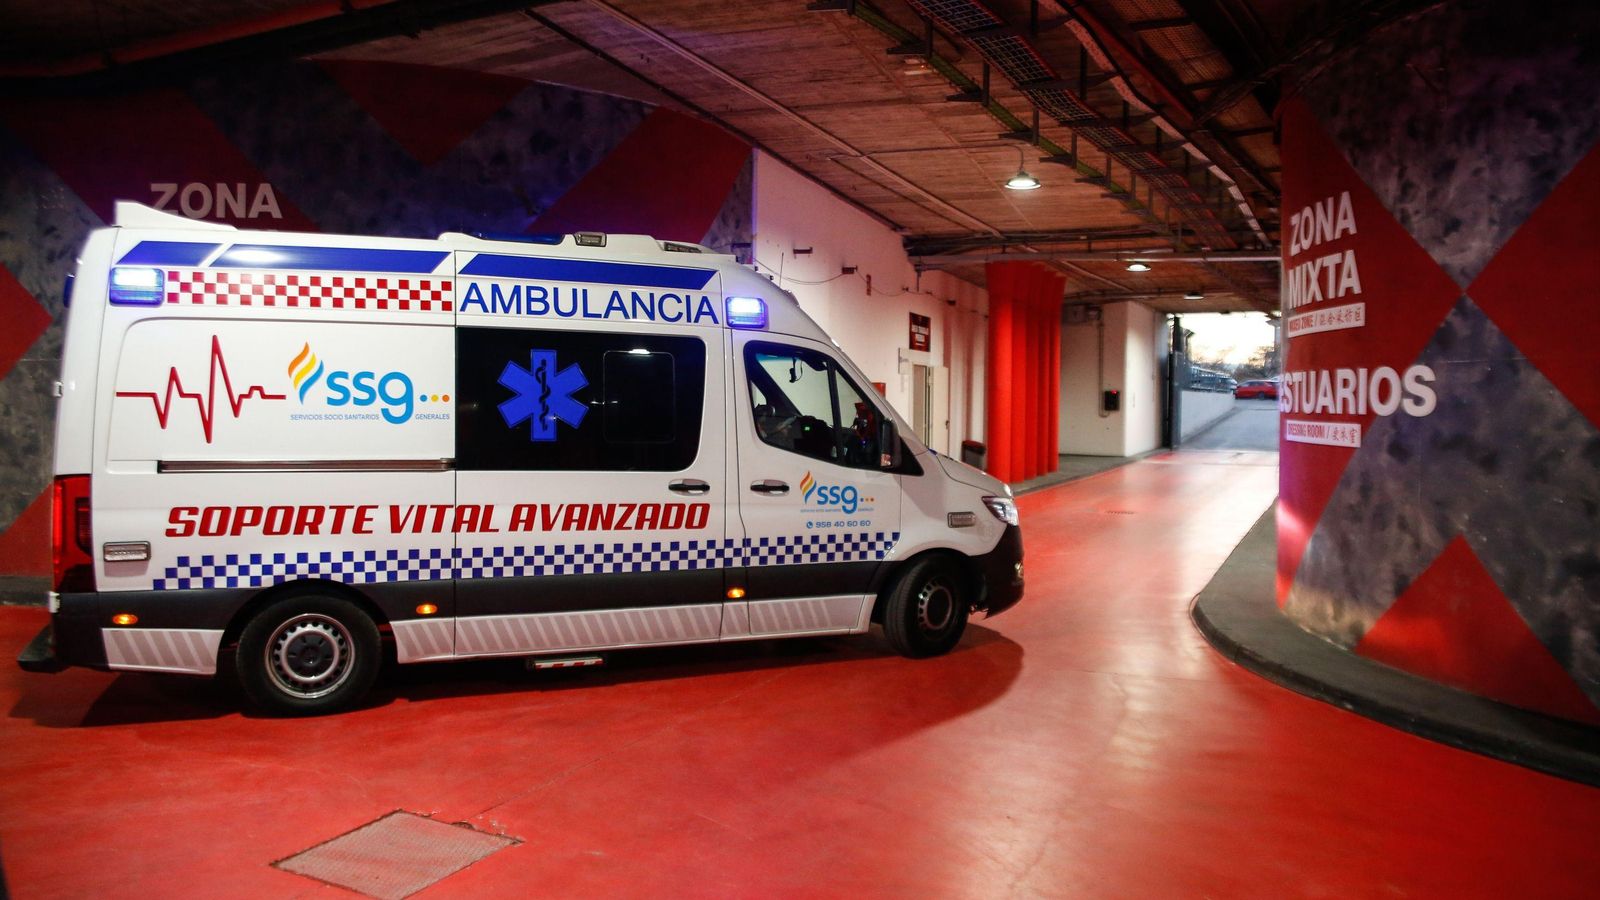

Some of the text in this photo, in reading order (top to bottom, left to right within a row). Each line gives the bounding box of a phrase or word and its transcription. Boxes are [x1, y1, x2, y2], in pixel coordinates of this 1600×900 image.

[150, 182, 282, 219] ZONA
[1290, 191, 1357, 256] ZONA
[1288, 249, 1362, 309] MIXTA
[460, 281, 720, 325] AMBULANCIA
[290, 413, 323, 421] SERVICIOS
[323, 413, 344, 421] SOCIO
[344, 413, 380, 421] SANITARIOS
[165, 503, 711, 538] SOPORTE VITAL AVANZADO
